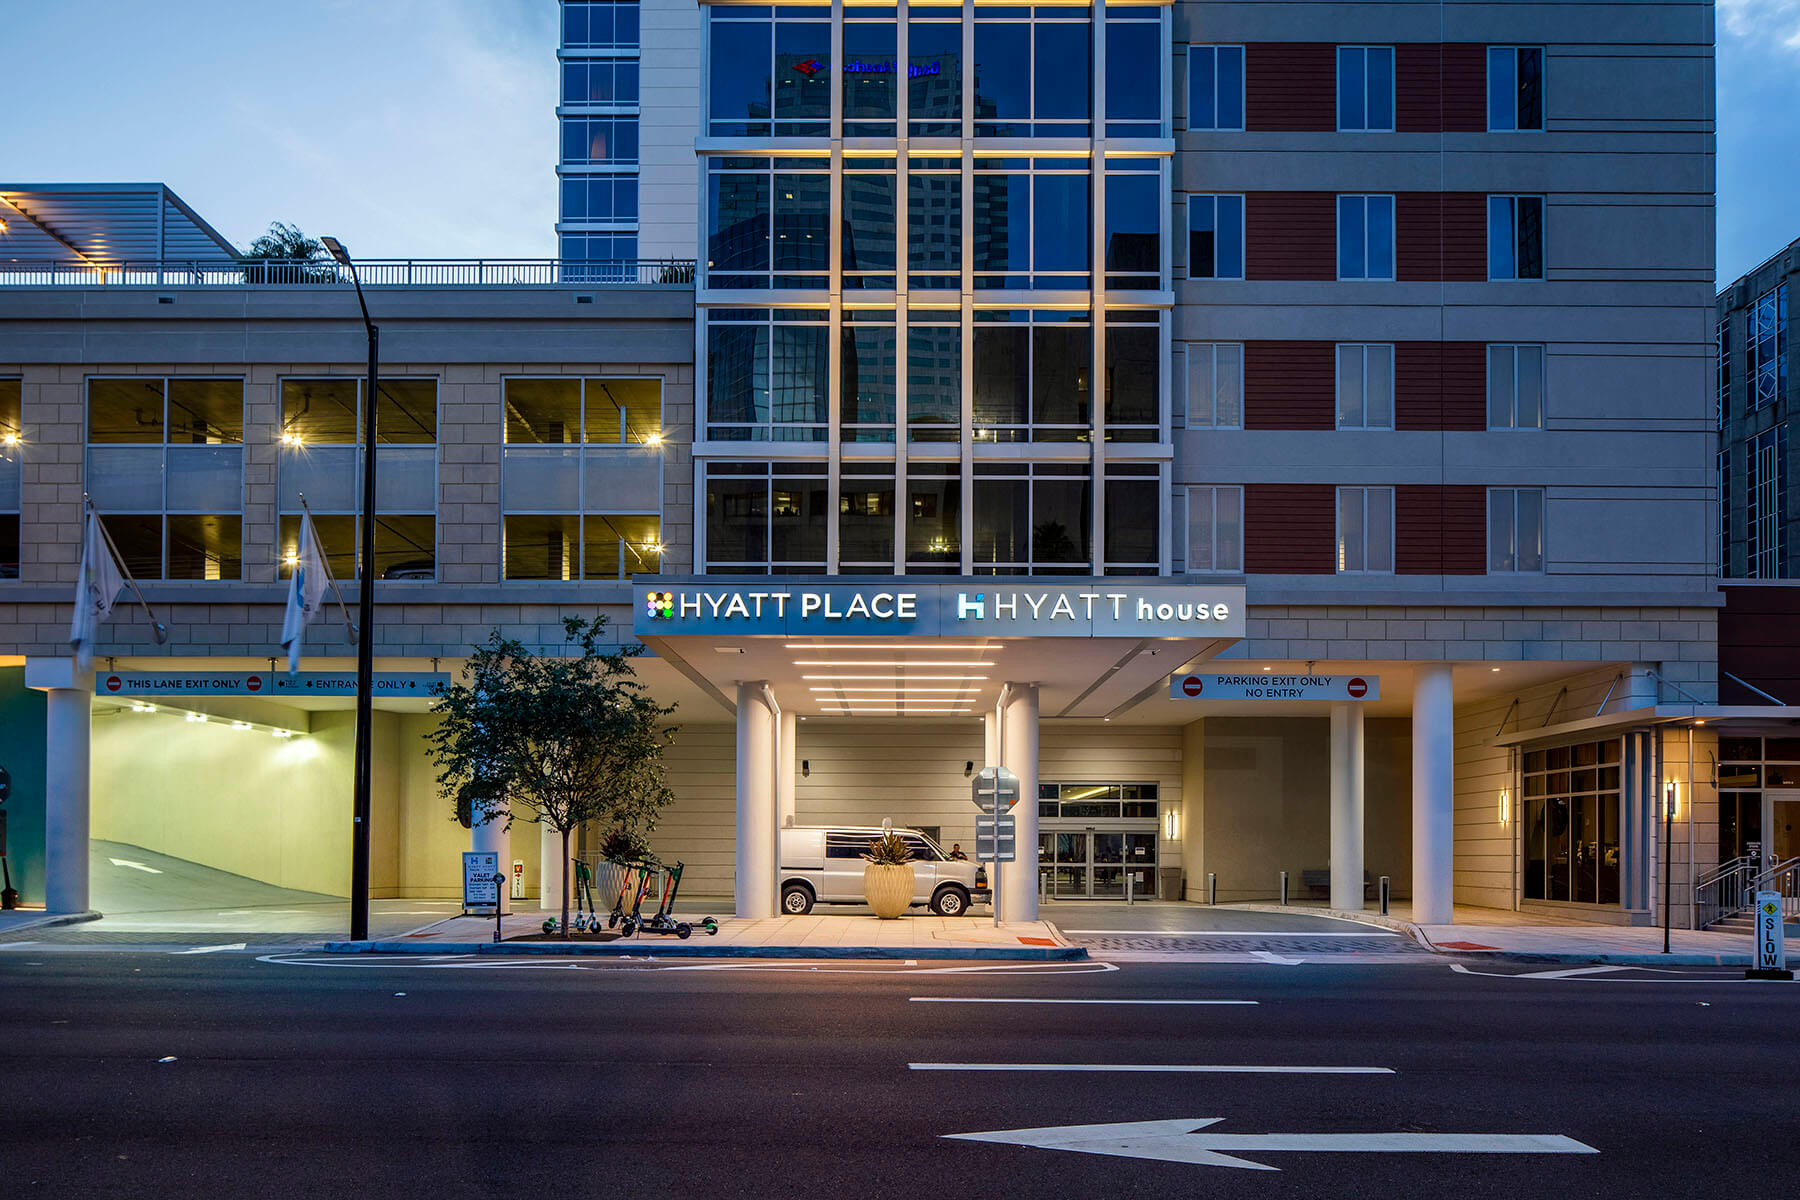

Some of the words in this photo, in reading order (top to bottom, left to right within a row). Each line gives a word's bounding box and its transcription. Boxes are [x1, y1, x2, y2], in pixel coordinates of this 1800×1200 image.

[680, 592, 790, 618] HYATT
[802, 592, 917, 618] PLACE
[995, 593, 1127, 620] HYATT
[1137, 597, 1229, 620] house
[127, 679, 152, 689] THIS
[153, 679, 181, 689] LANE
[185, 679, 210, 689] EXIT
[211, 679, 241, 689] ONLY
[316, 679, 374, 689] ENTRAN
[377, 680, 407, 689] ONLY
[1217, 676, 1269, 686] PARKING
[1272, 677, 1297, 686] EXIT
[1300, 677, 1332, 687] ONLY
[1245, 688, 1263, 698] NO
[1266, 688, 1304, 698] ENTRY
[1763, 917, 1777, 966] SLOW
